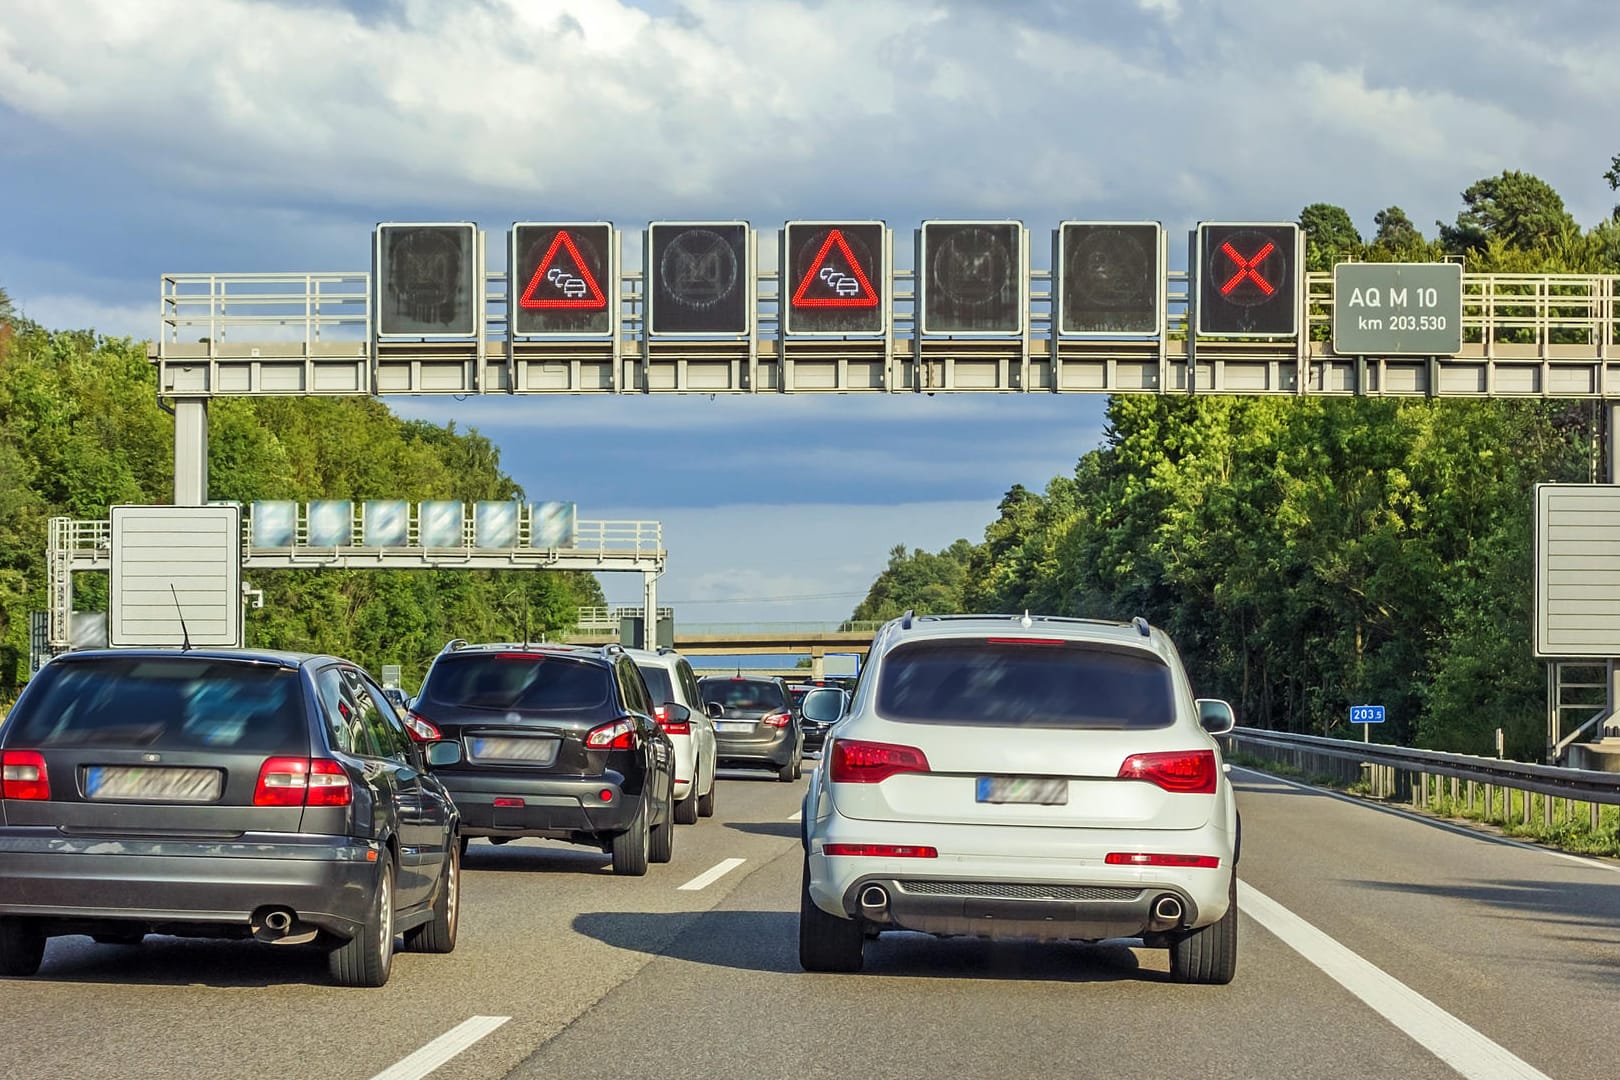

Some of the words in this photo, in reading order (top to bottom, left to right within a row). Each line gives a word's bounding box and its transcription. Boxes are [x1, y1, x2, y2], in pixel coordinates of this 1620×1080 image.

[1348, 287, 1381, 308] AQ
[1389, 287, 1408, 308] M
[1416, 287, 1438, 308] 10
[1358, 315, 1383, 331] km
[1389, 315, 1447, 332] 203.530
